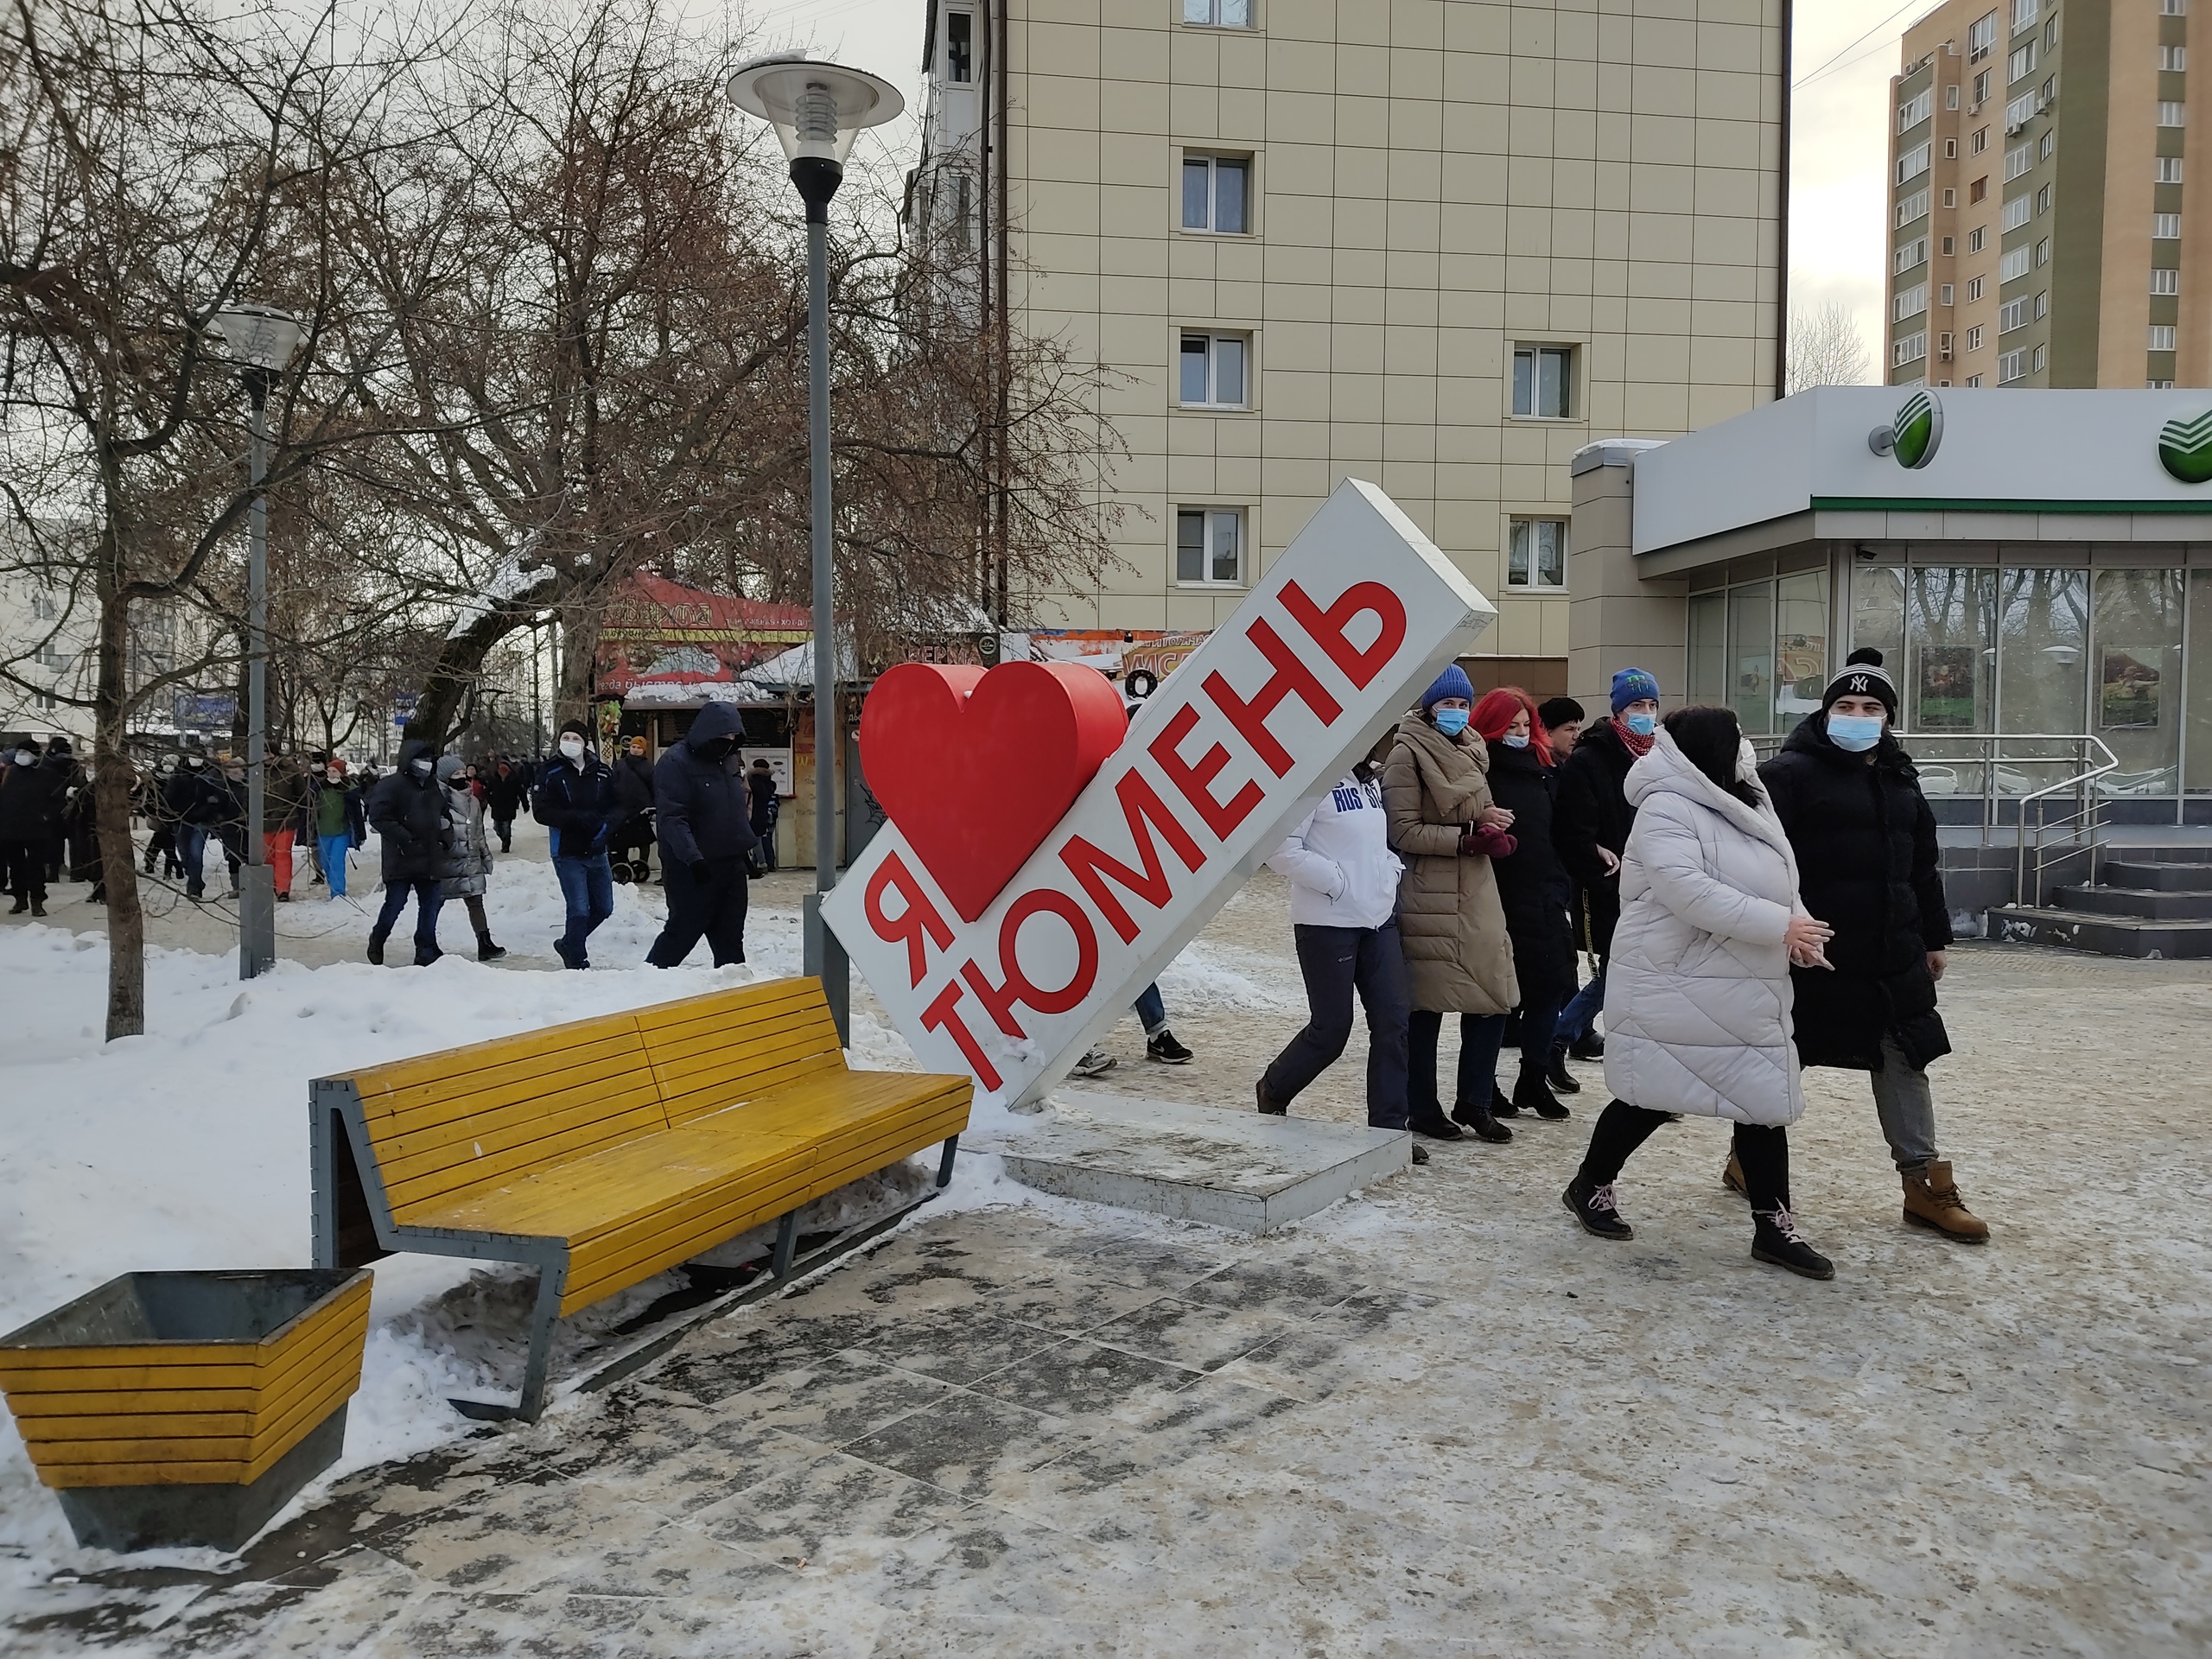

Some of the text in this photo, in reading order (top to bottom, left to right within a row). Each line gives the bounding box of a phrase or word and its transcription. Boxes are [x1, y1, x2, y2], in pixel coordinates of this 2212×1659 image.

[920, 579, 1407, 1092] ТЮМЕНЬ
[1332, 787, 1363, 813] RUS
[864, 850, 955, 990] Я
